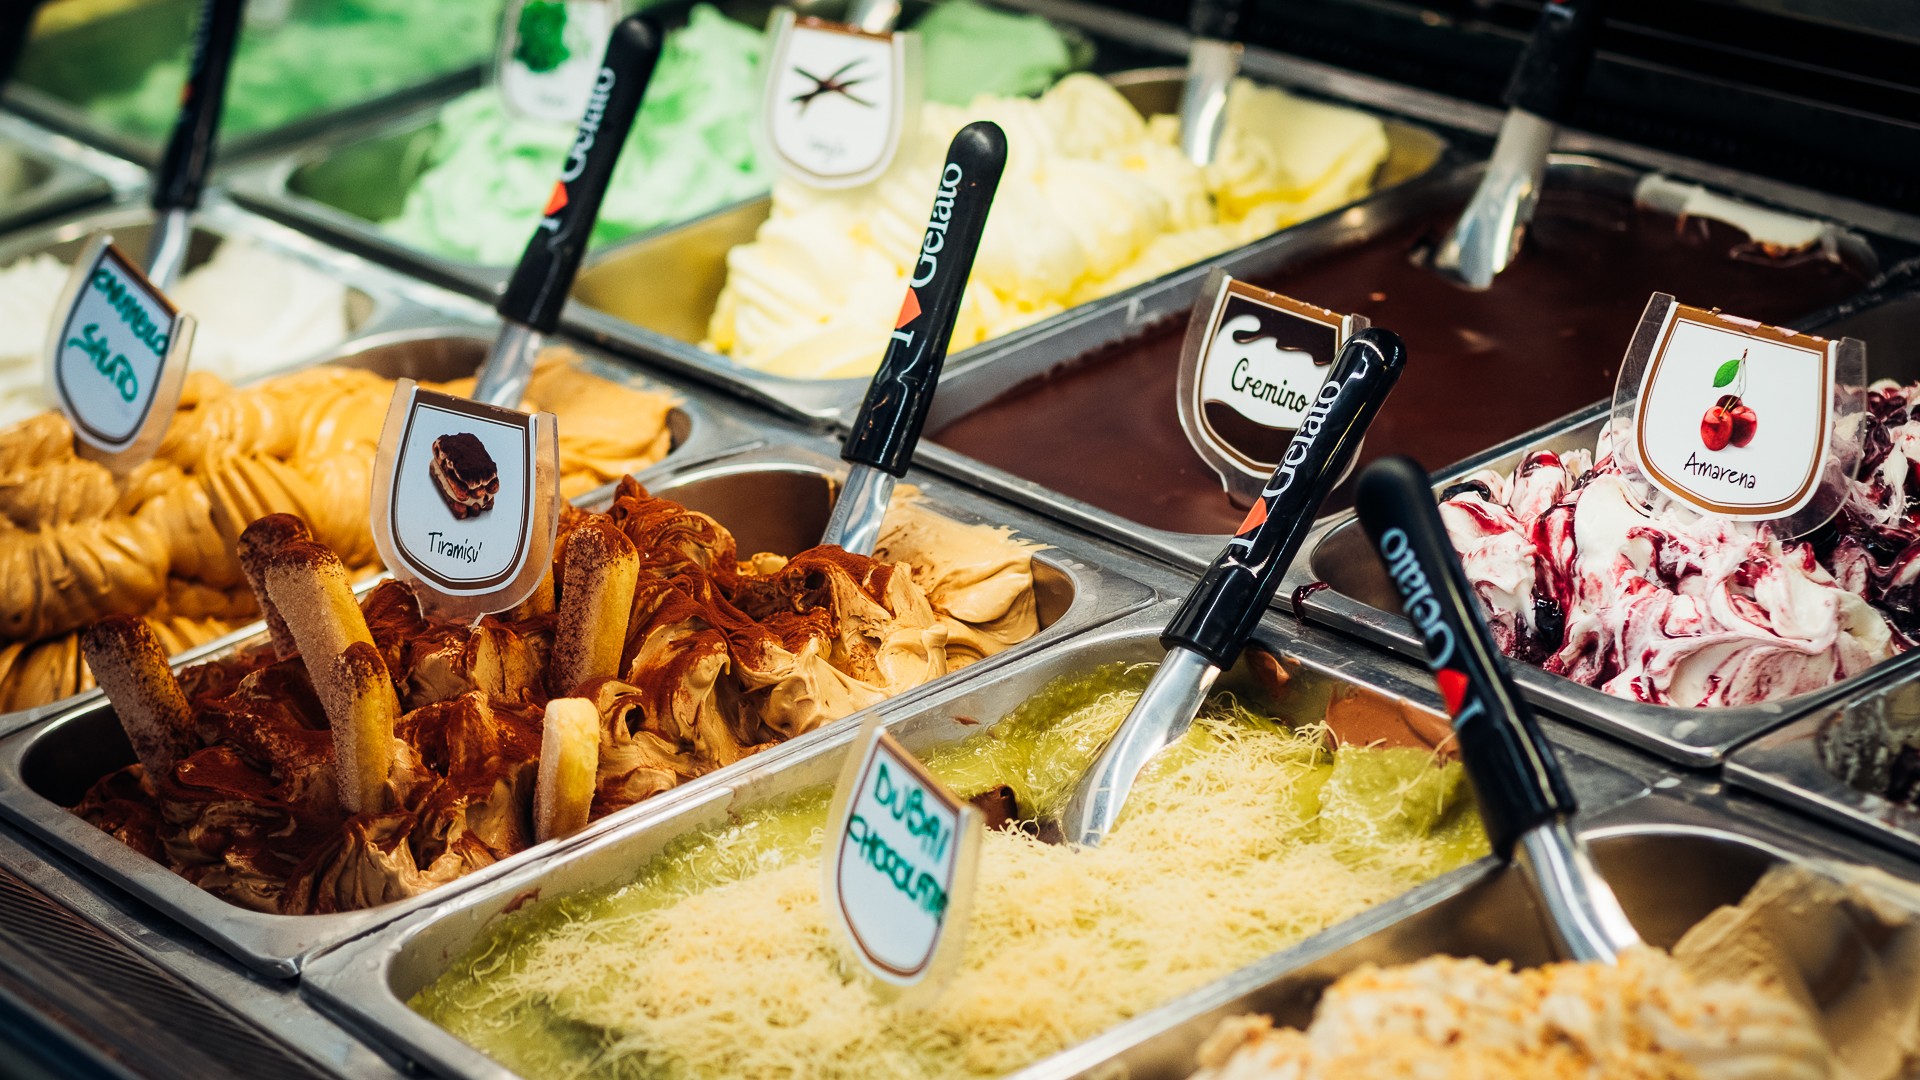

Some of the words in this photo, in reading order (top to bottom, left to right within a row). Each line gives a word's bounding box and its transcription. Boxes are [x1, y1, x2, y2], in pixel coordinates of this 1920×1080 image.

[559, 66, 617, 183] Gelato
[910, 162, 963, 289] Gelato
[1231, 357, 1310, 413] Cremino
[1261, 380, 1341, 498] Gelato
[1683, 451, 1757, 489] Amarena
[1380, 527, 1455, 670] Gelato
[874, 762, 951, 864] DUBAI
